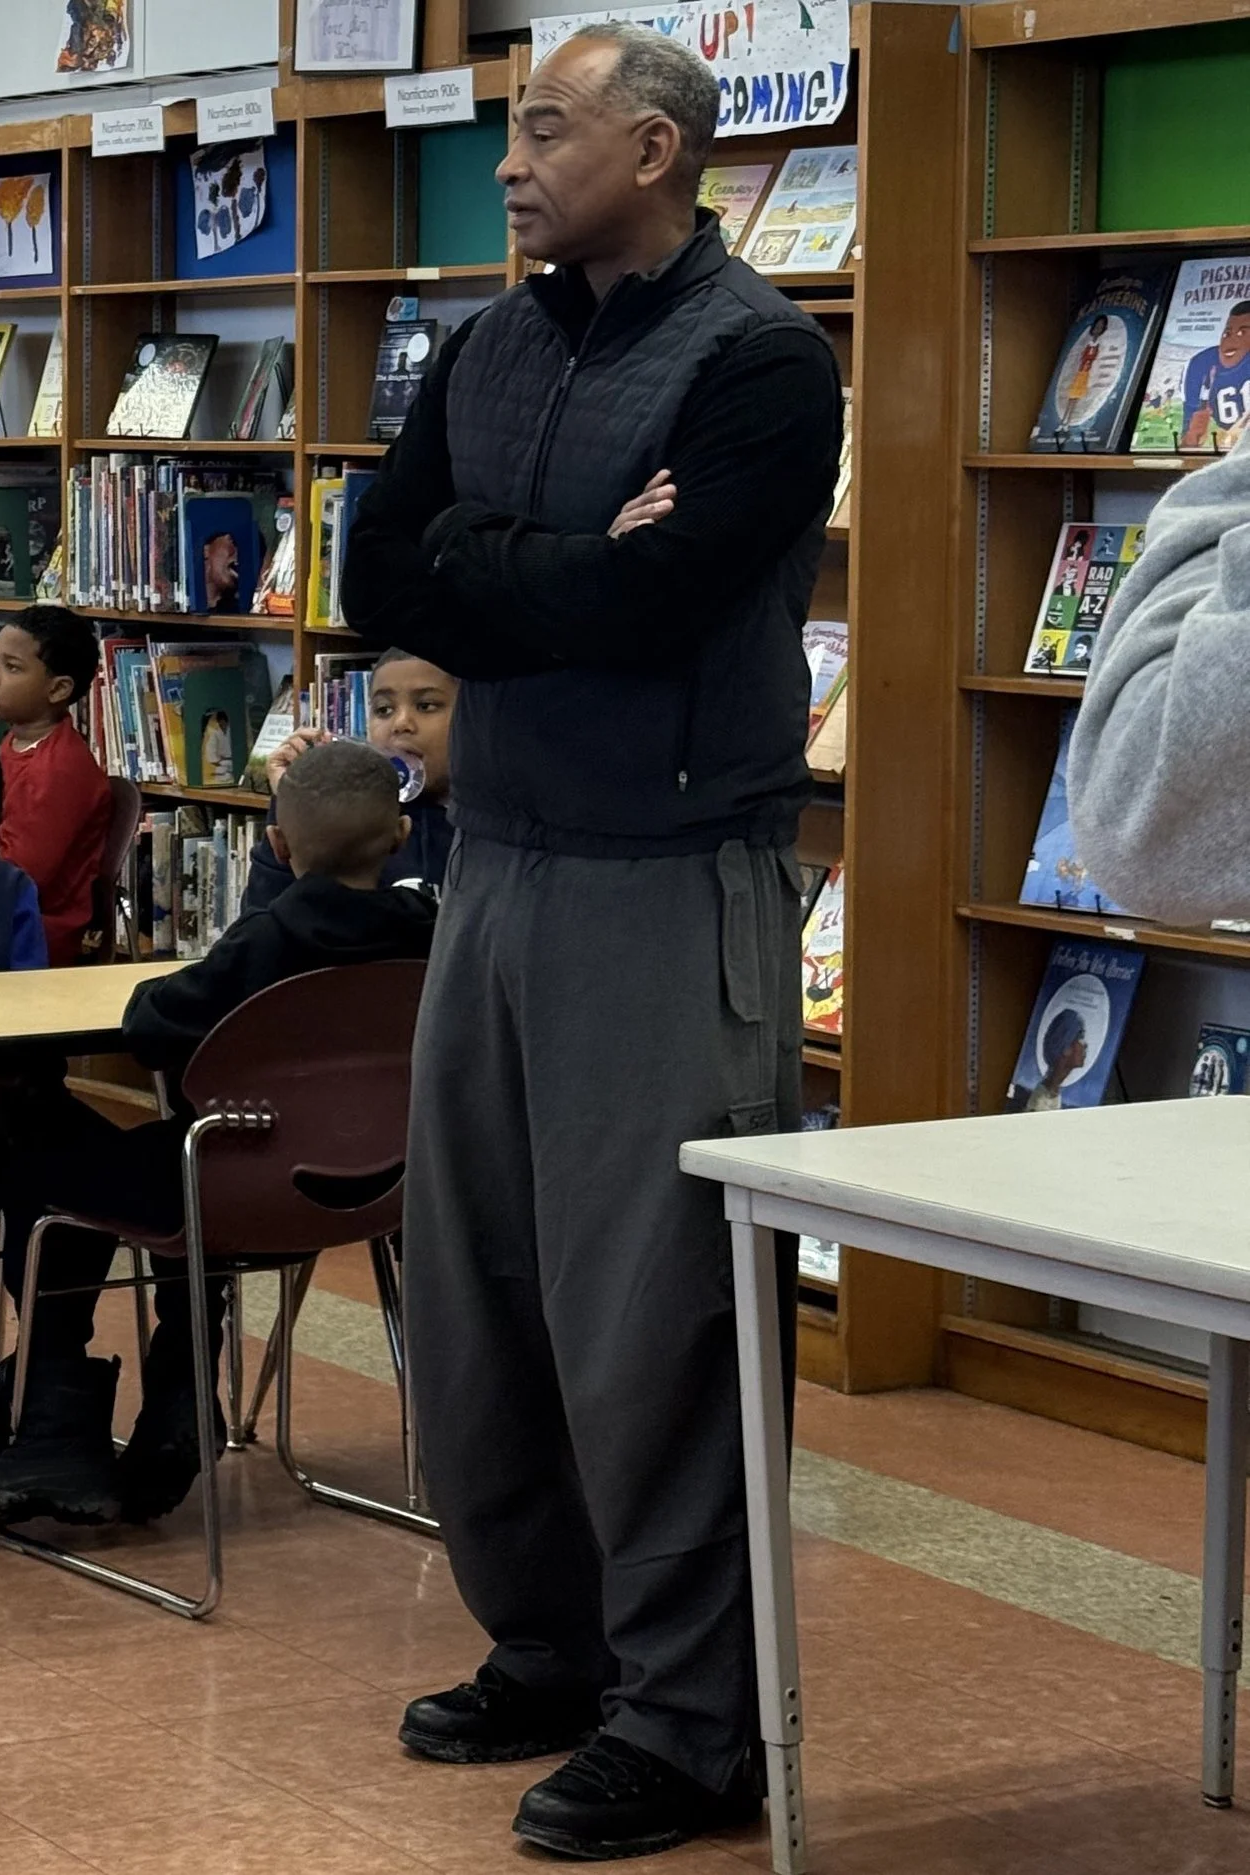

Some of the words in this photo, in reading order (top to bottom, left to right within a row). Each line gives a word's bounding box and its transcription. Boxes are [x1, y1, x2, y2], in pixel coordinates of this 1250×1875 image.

[700, 3, 754, 60] UP!
[398, 86, 439, 102] Nonfiction
[717, 62, 845, 125] COMING!
[207, 103, 244, 120] Nonfiction
[1087, 566, 1114, 581] RAD
[1078, 595, 1106, 614] A-Z
